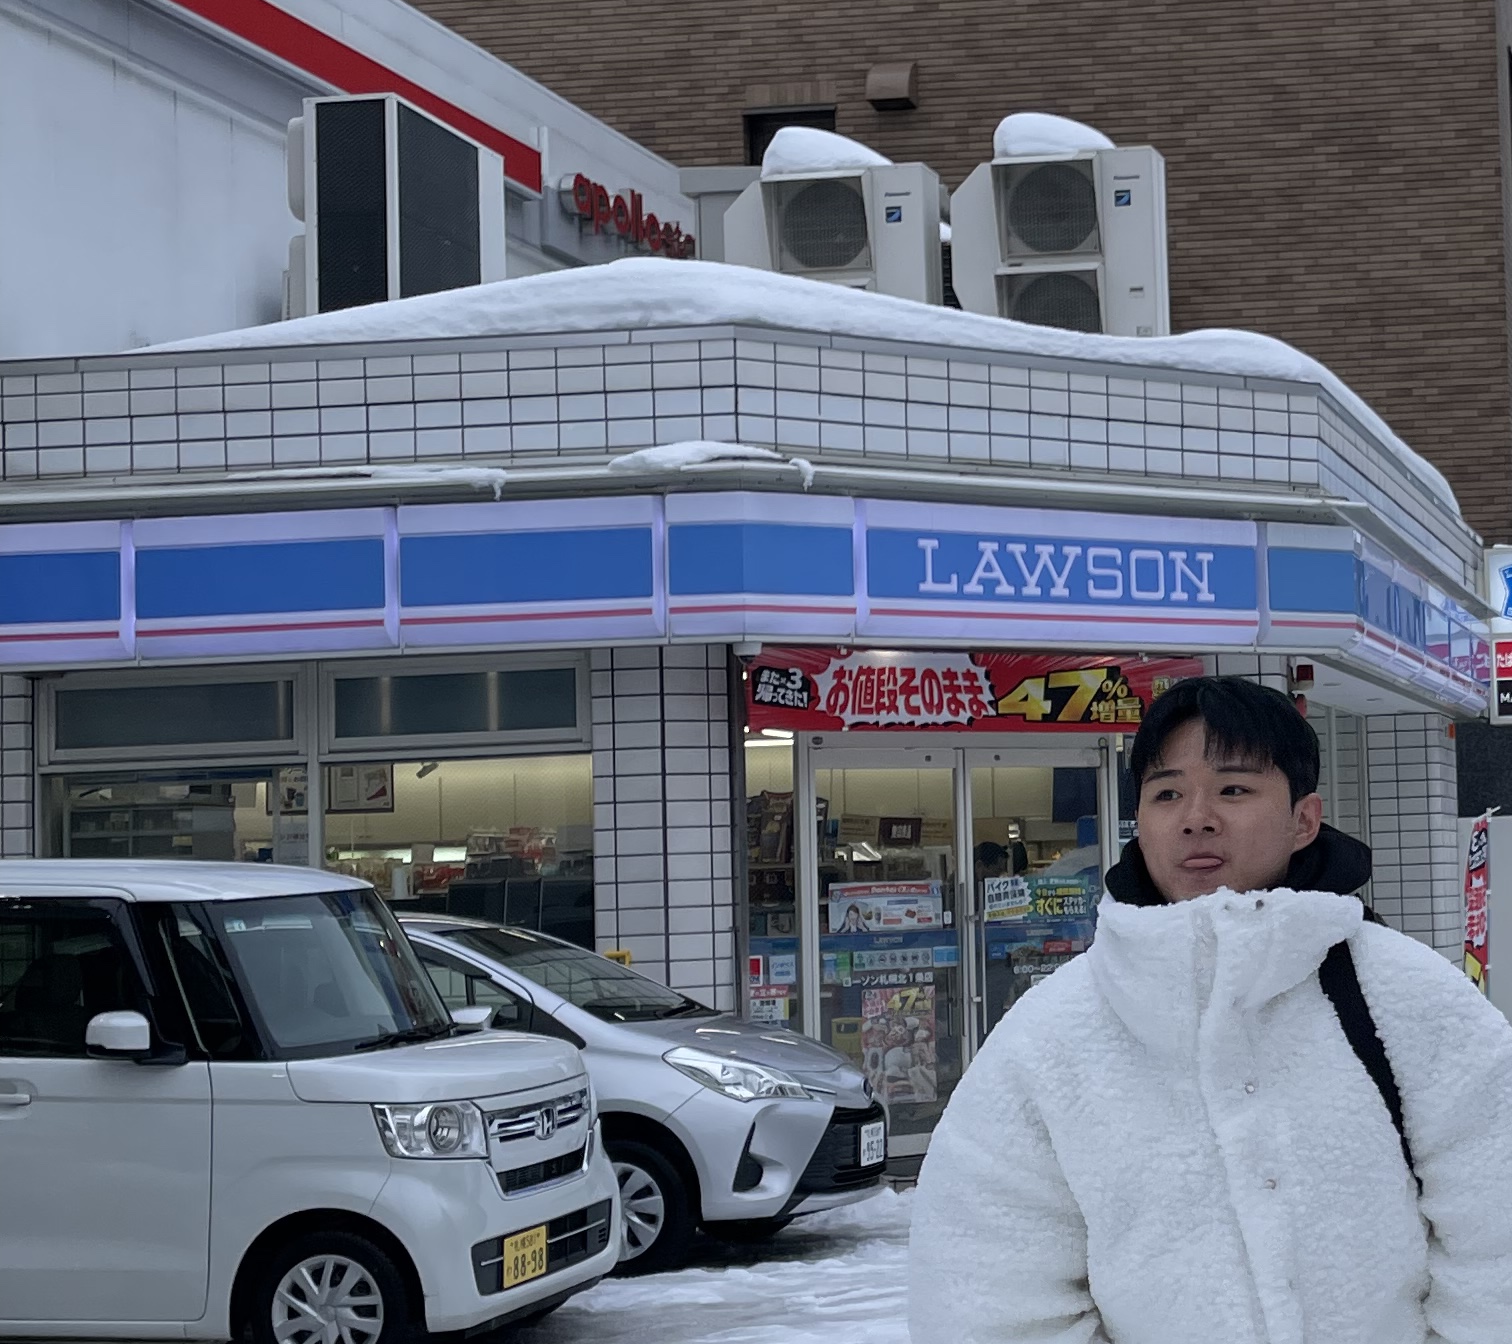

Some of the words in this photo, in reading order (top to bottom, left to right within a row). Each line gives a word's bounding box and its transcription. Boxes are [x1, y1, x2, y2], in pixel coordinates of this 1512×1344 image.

[917, 538, 1215, 602] LAWSON
[826, 665, 987, 717] お値段そのまま
[513, 1247, 544, 1280] 88-98
